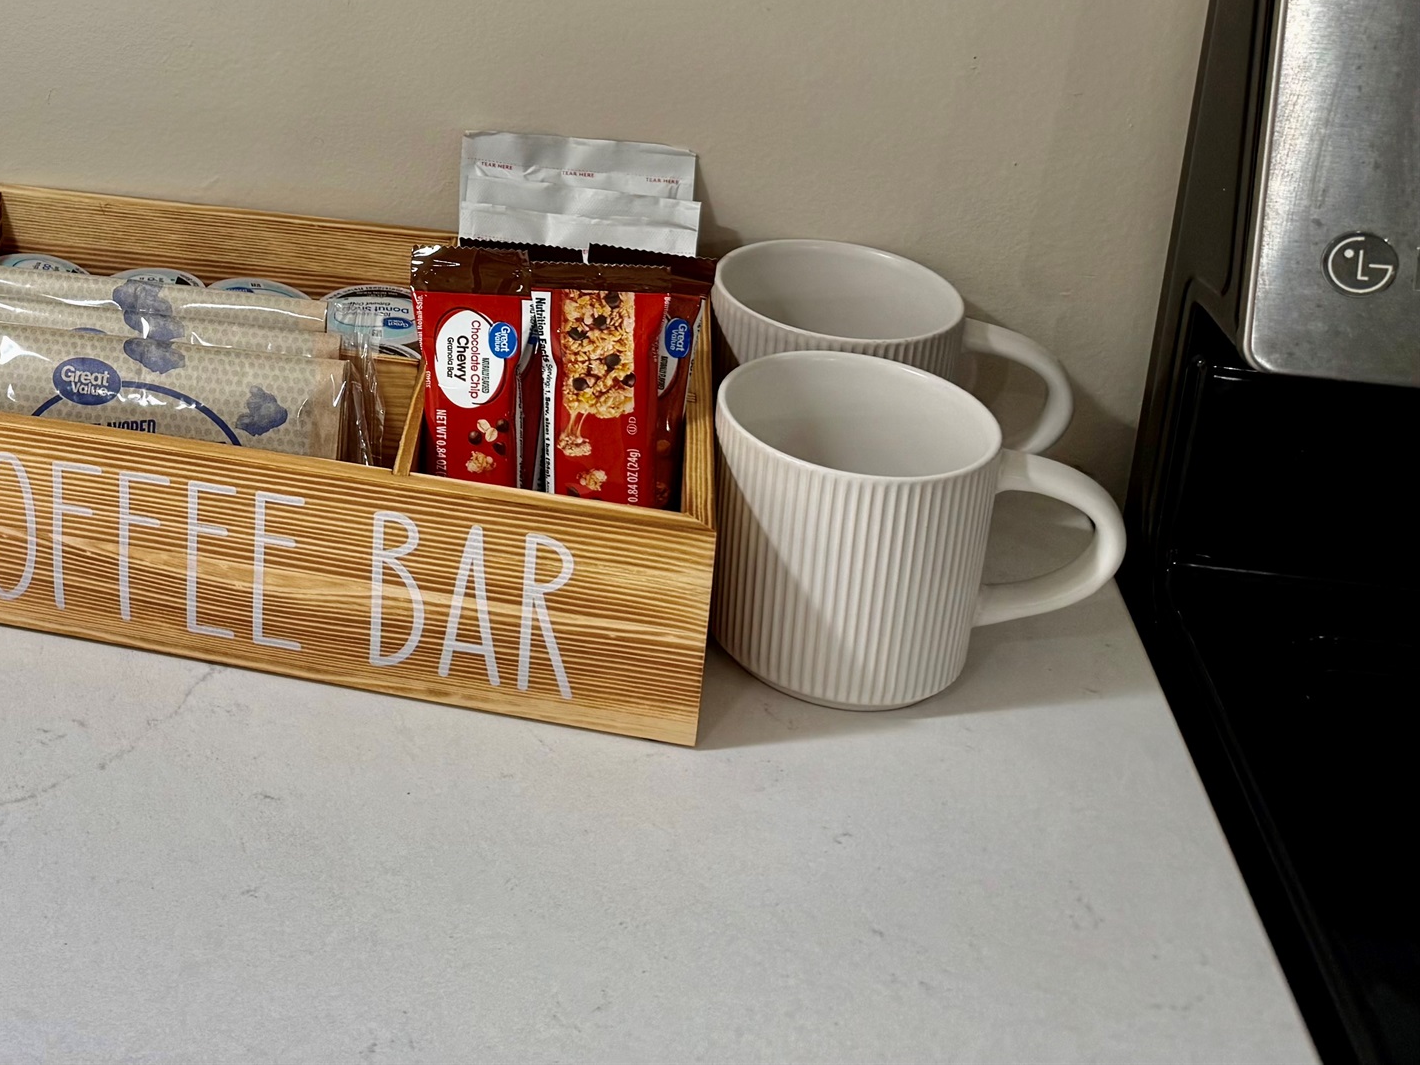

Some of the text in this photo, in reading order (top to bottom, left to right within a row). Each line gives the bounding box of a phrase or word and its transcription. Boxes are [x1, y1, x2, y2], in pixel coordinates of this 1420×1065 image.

[481, 161, 513, 171] TEAR HERE
[1326, 235, 1394, 294] LG
[374, 306, 410, 314] Donut
[535, 297, 546, 336] Nutrition
[494, 331, 502, 352] Value
[500, 325, 511, 352] Great
[669, 329, 679, 351] Value
[675, 323, 688, 352] Great
[447, 337, 455, 379] Granola Bar
[454, 335, 469, 382] Chewy
[468, 319, 481, 399] Chocolate Chip
[60, 365, 110, 387] Great
[71, 382, 109, 397] Value
[436, 409, 447, 425] NET
[436, 426, 447, 439] WT
[435, 440, 447, 459] 0.84
[435, 460, 447, 471] OZ
[626, 448, 641, 503] 0.84 OZ (24g)
[368, 509, 574, 700] BAR
